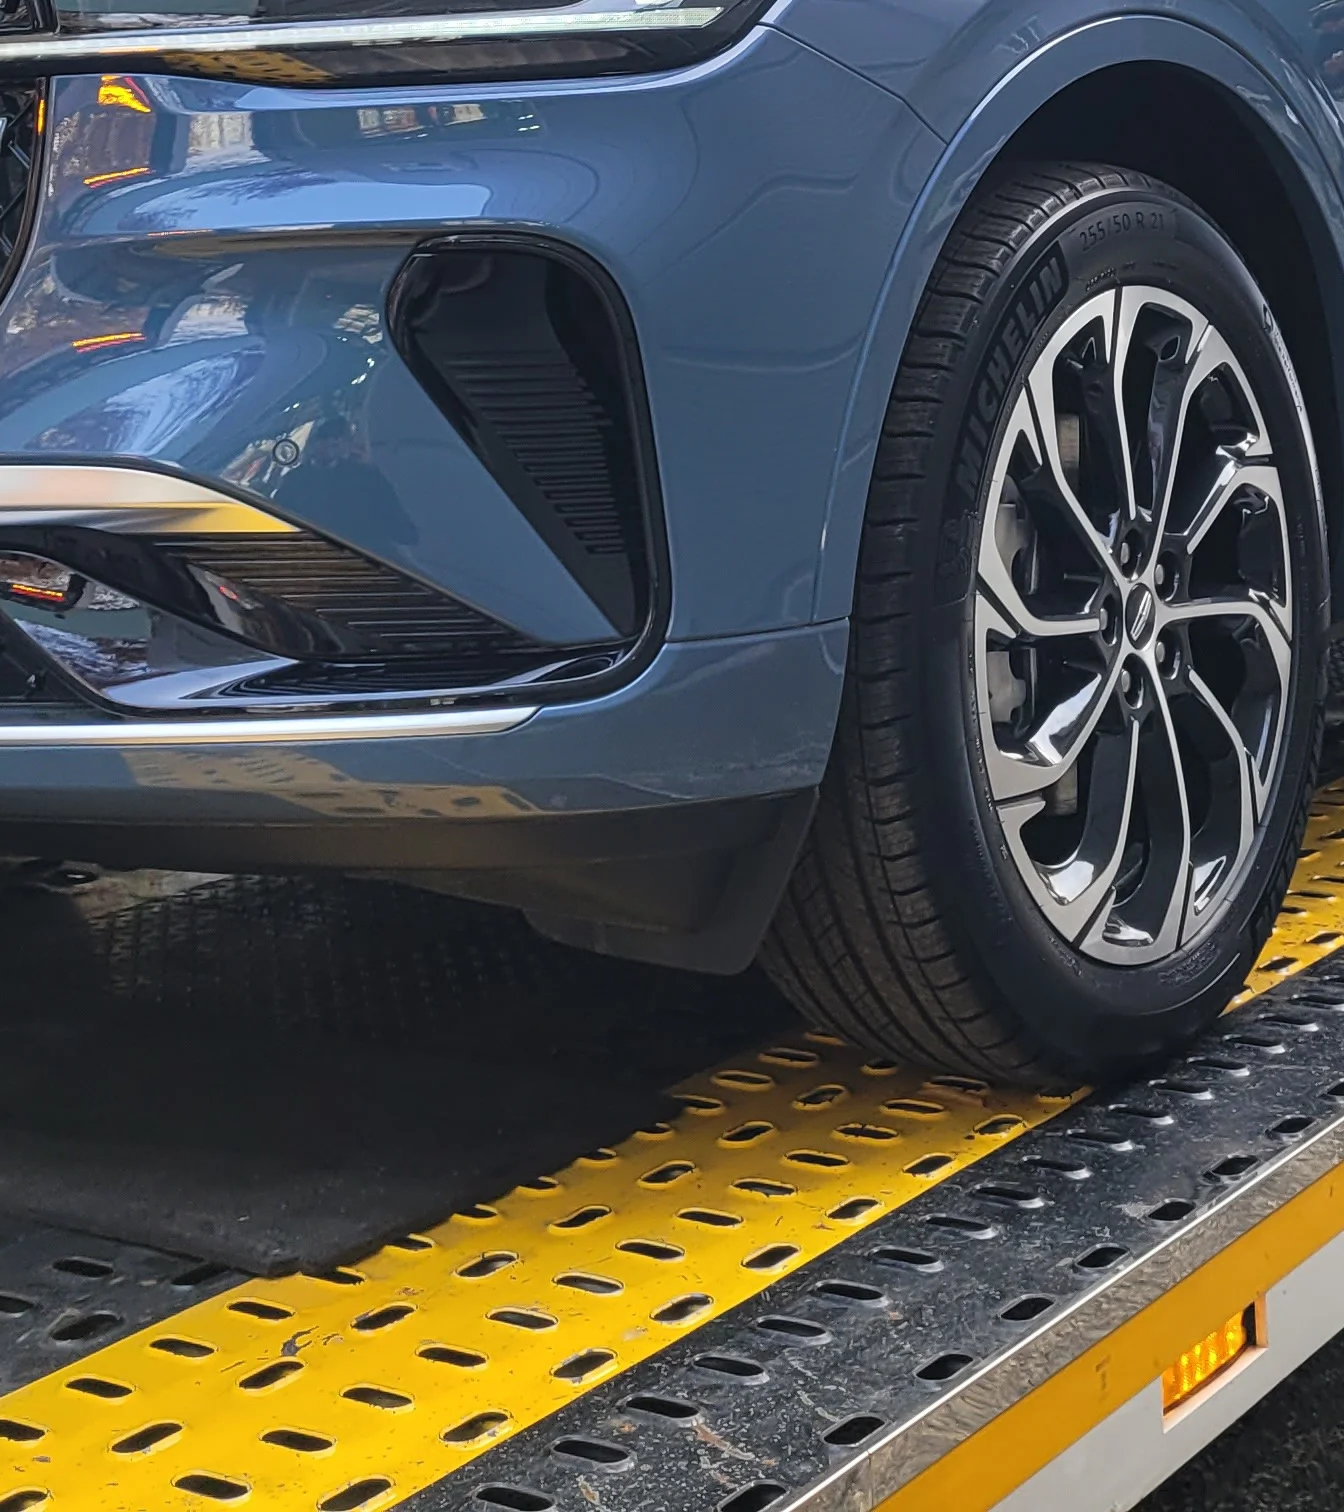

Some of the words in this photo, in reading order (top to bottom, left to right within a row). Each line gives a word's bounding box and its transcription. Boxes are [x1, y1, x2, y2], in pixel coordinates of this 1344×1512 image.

[1078, 211, 1132, 252] 255/50
[1136, 211, 1145, 230] R
[955, 255, 1064, 504] MICHELIN
